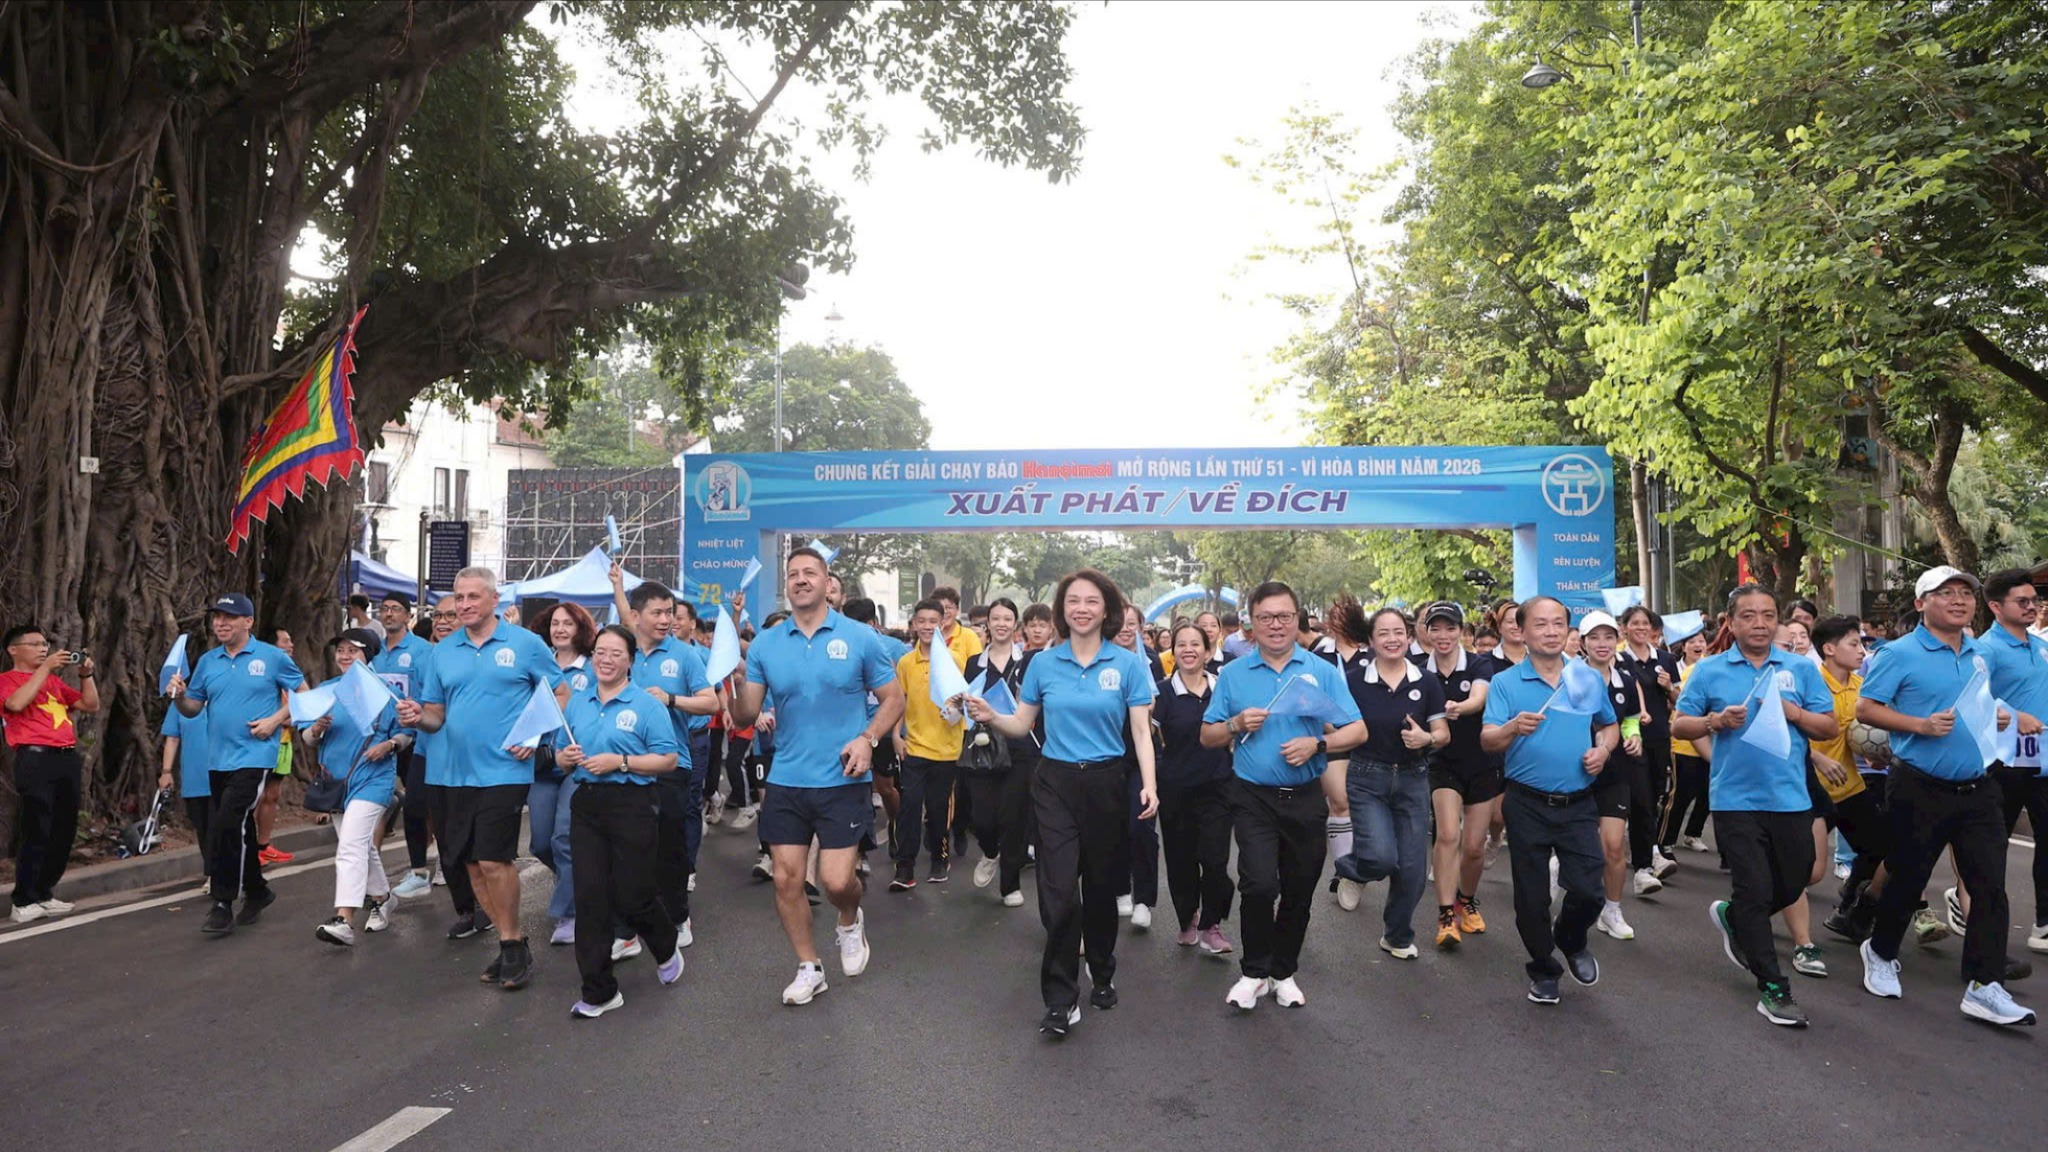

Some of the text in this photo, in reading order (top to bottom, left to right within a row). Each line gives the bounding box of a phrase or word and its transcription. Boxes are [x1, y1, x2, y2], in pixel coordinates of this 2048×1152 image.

[814, 464, 867, 481] CHUNG
[871, 458, 900, 480] KẾT
[905, 458, 936, 480] GIẢI
[941, 463, 982, 482] CHẠY
[986, 458, 1018, 479] BÁO
[1117, 456, 1143, 478] MỞ
[1148, 457, 1191, 480] RỘNG
[1232, 457, 1264, 477] THỨ
[1267, 460, 1284, 477] 51
[1302, 456, 1316, 477] VÌ
[1321, 456, 1353, 476] HÒA
[1358, 456, 1396, 476] BÌNH
[1401, 456, 1438, 476] NĂM
[1443, 459, 1482, 475] 2026
[944, 482, 1052, 516] XUẤT
[1245, 483, 1350, 514] ĐÍCH
[1553, 532, 1600, 542] TOÀN DÂN
[698, 538, 744, 550] NHIỆT LIỆT
[693, 559, 721, 569] CHÀO
[1554, 556, 1601, 568] RÈN LUYỆN
[1556, 581, 1580, 591] THÂN
[699, 583, 721, 604] 72
